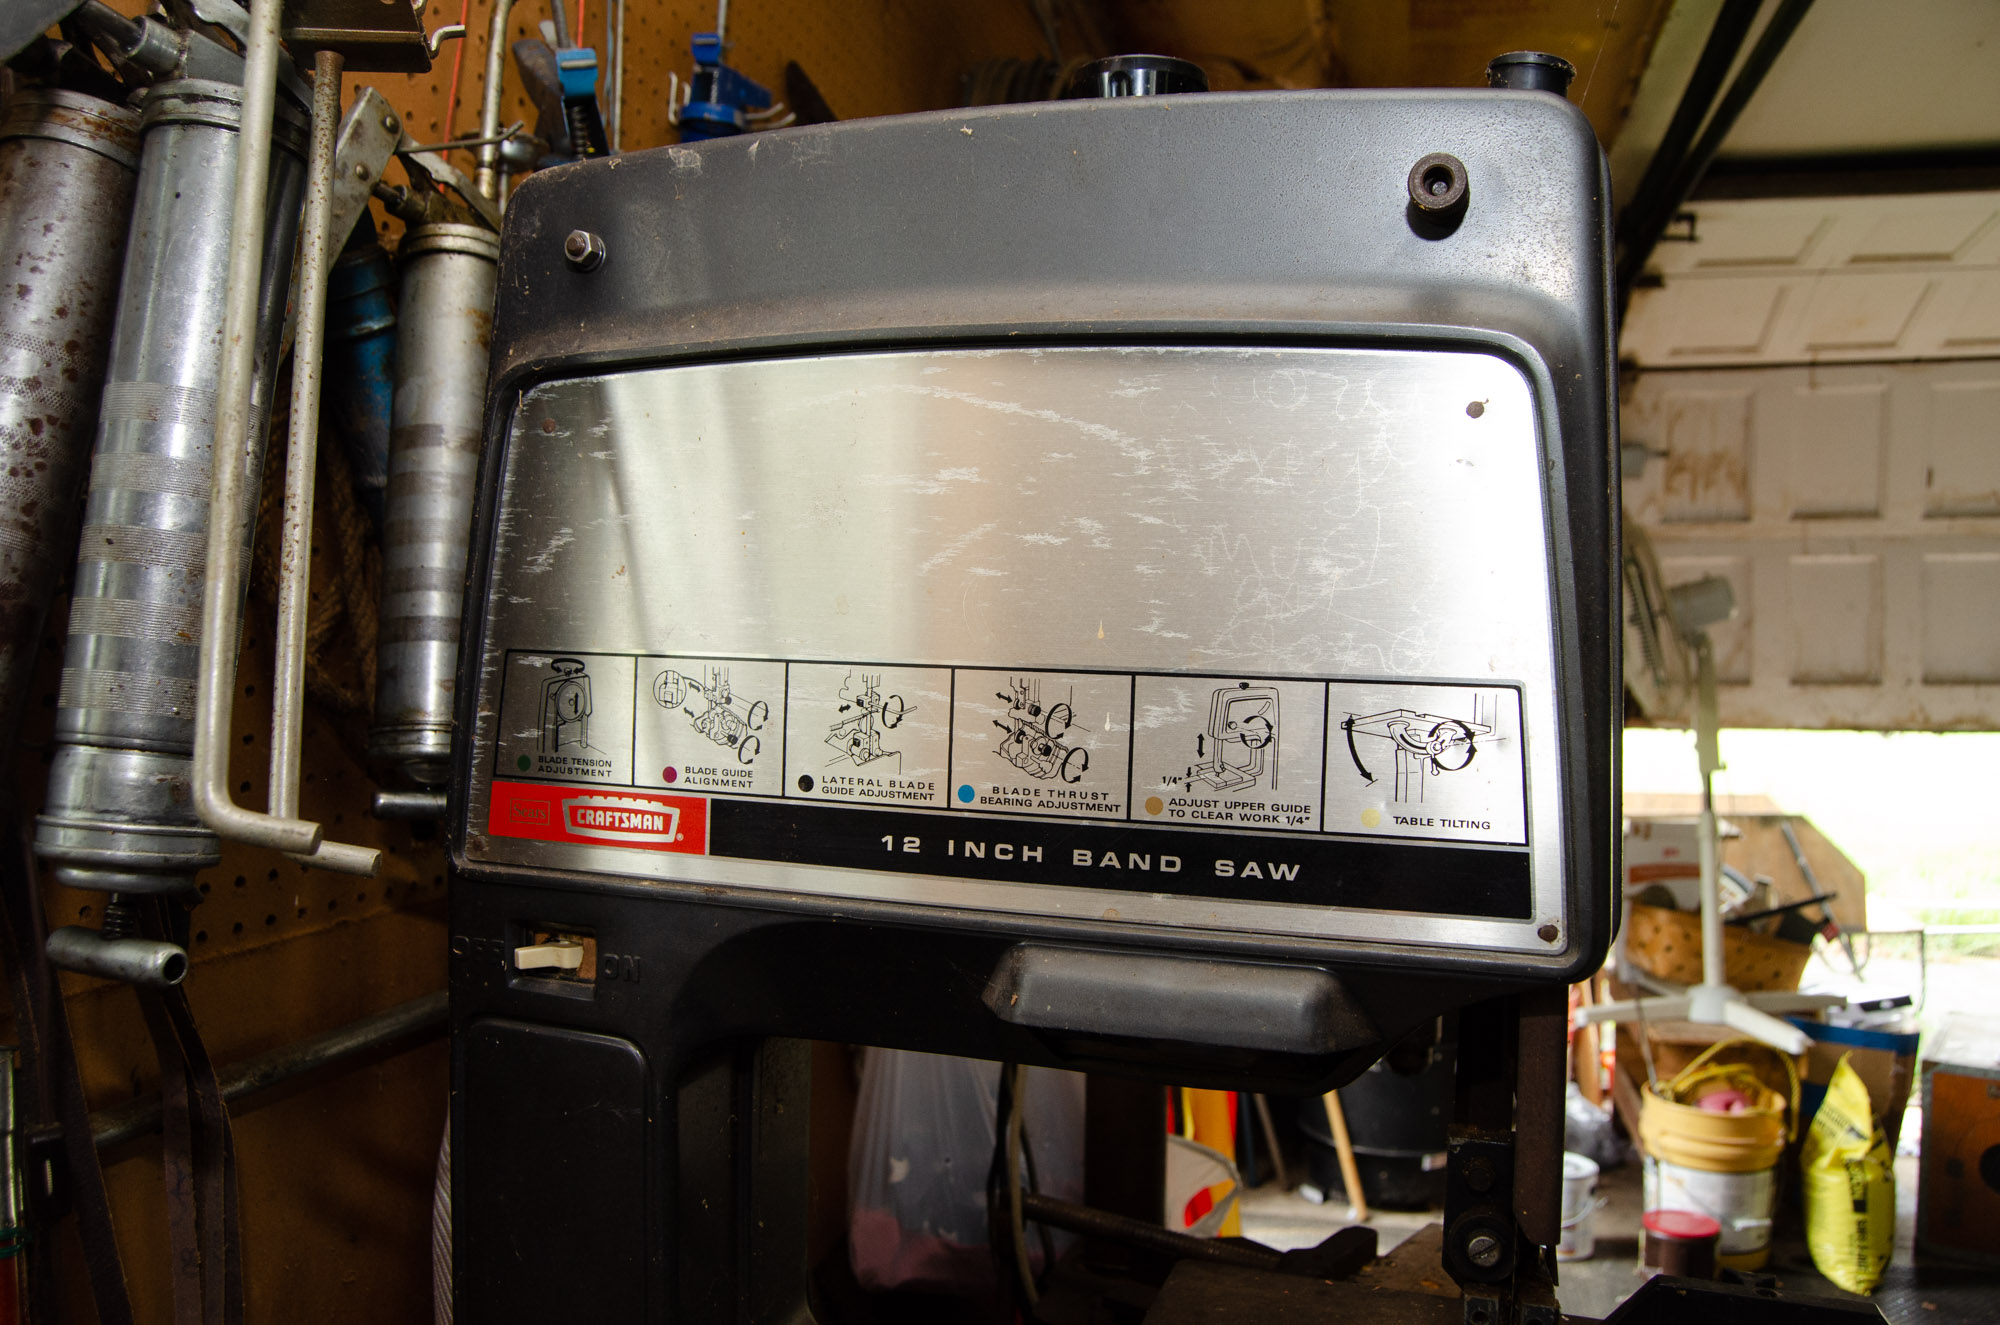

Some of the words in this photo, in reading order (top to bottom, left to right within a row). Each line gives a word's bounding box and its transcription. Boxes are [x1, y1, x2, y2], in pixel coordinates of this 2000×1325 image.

[538, 755, 568, 765] BLADE
[571, 757, 612, 768] TENSION
[537, 765, 613, 778] ADJUSTMENT
[685, 766, 718, 776] BLADE
[721, 768, 754, 778] GUIDE
[684, 776, 754, 789] ALIGNMENT
[822, 775, 884, 788] LATERAL
[889, 779, 935, 791] BLADE
[821, 786, 855, 797] GUIDE
[858, 788, 935, 801] ADJUSTMENT
[992, 786, 1042, 798] BLADE
[1047, 789, 1110, 801] THRUST
[513, 802, 547, 819] Sears
[980, 796, 1034, 808] BEARING
[1036, 799, 1122, 813] ADJUSTMENT
[1169, 798, 1220, 809] ADJUST
[1224, 801, 1267, 812] UPPER
[1271, 803, 1311, 814] GUIDE
[577, 809, 664, 831] CRAFTSMAN
[1168, 809, 1186, 818] TO
[1191, 810, 1234, 822] CLEAR
[1238, 812, 1281, 824] WORK
[1285, 814, 1311, 826] 1/4"
[1393, 815, 1435, 827] TABLE
[1439, 818, 1492, 831] TILTING
[881, 835, 921, 853] 12
[948, 839, 1043, 863] INCH
[1072, 849, 1182, 873] BAND
[1215, 858, 1301, 881] SAW
